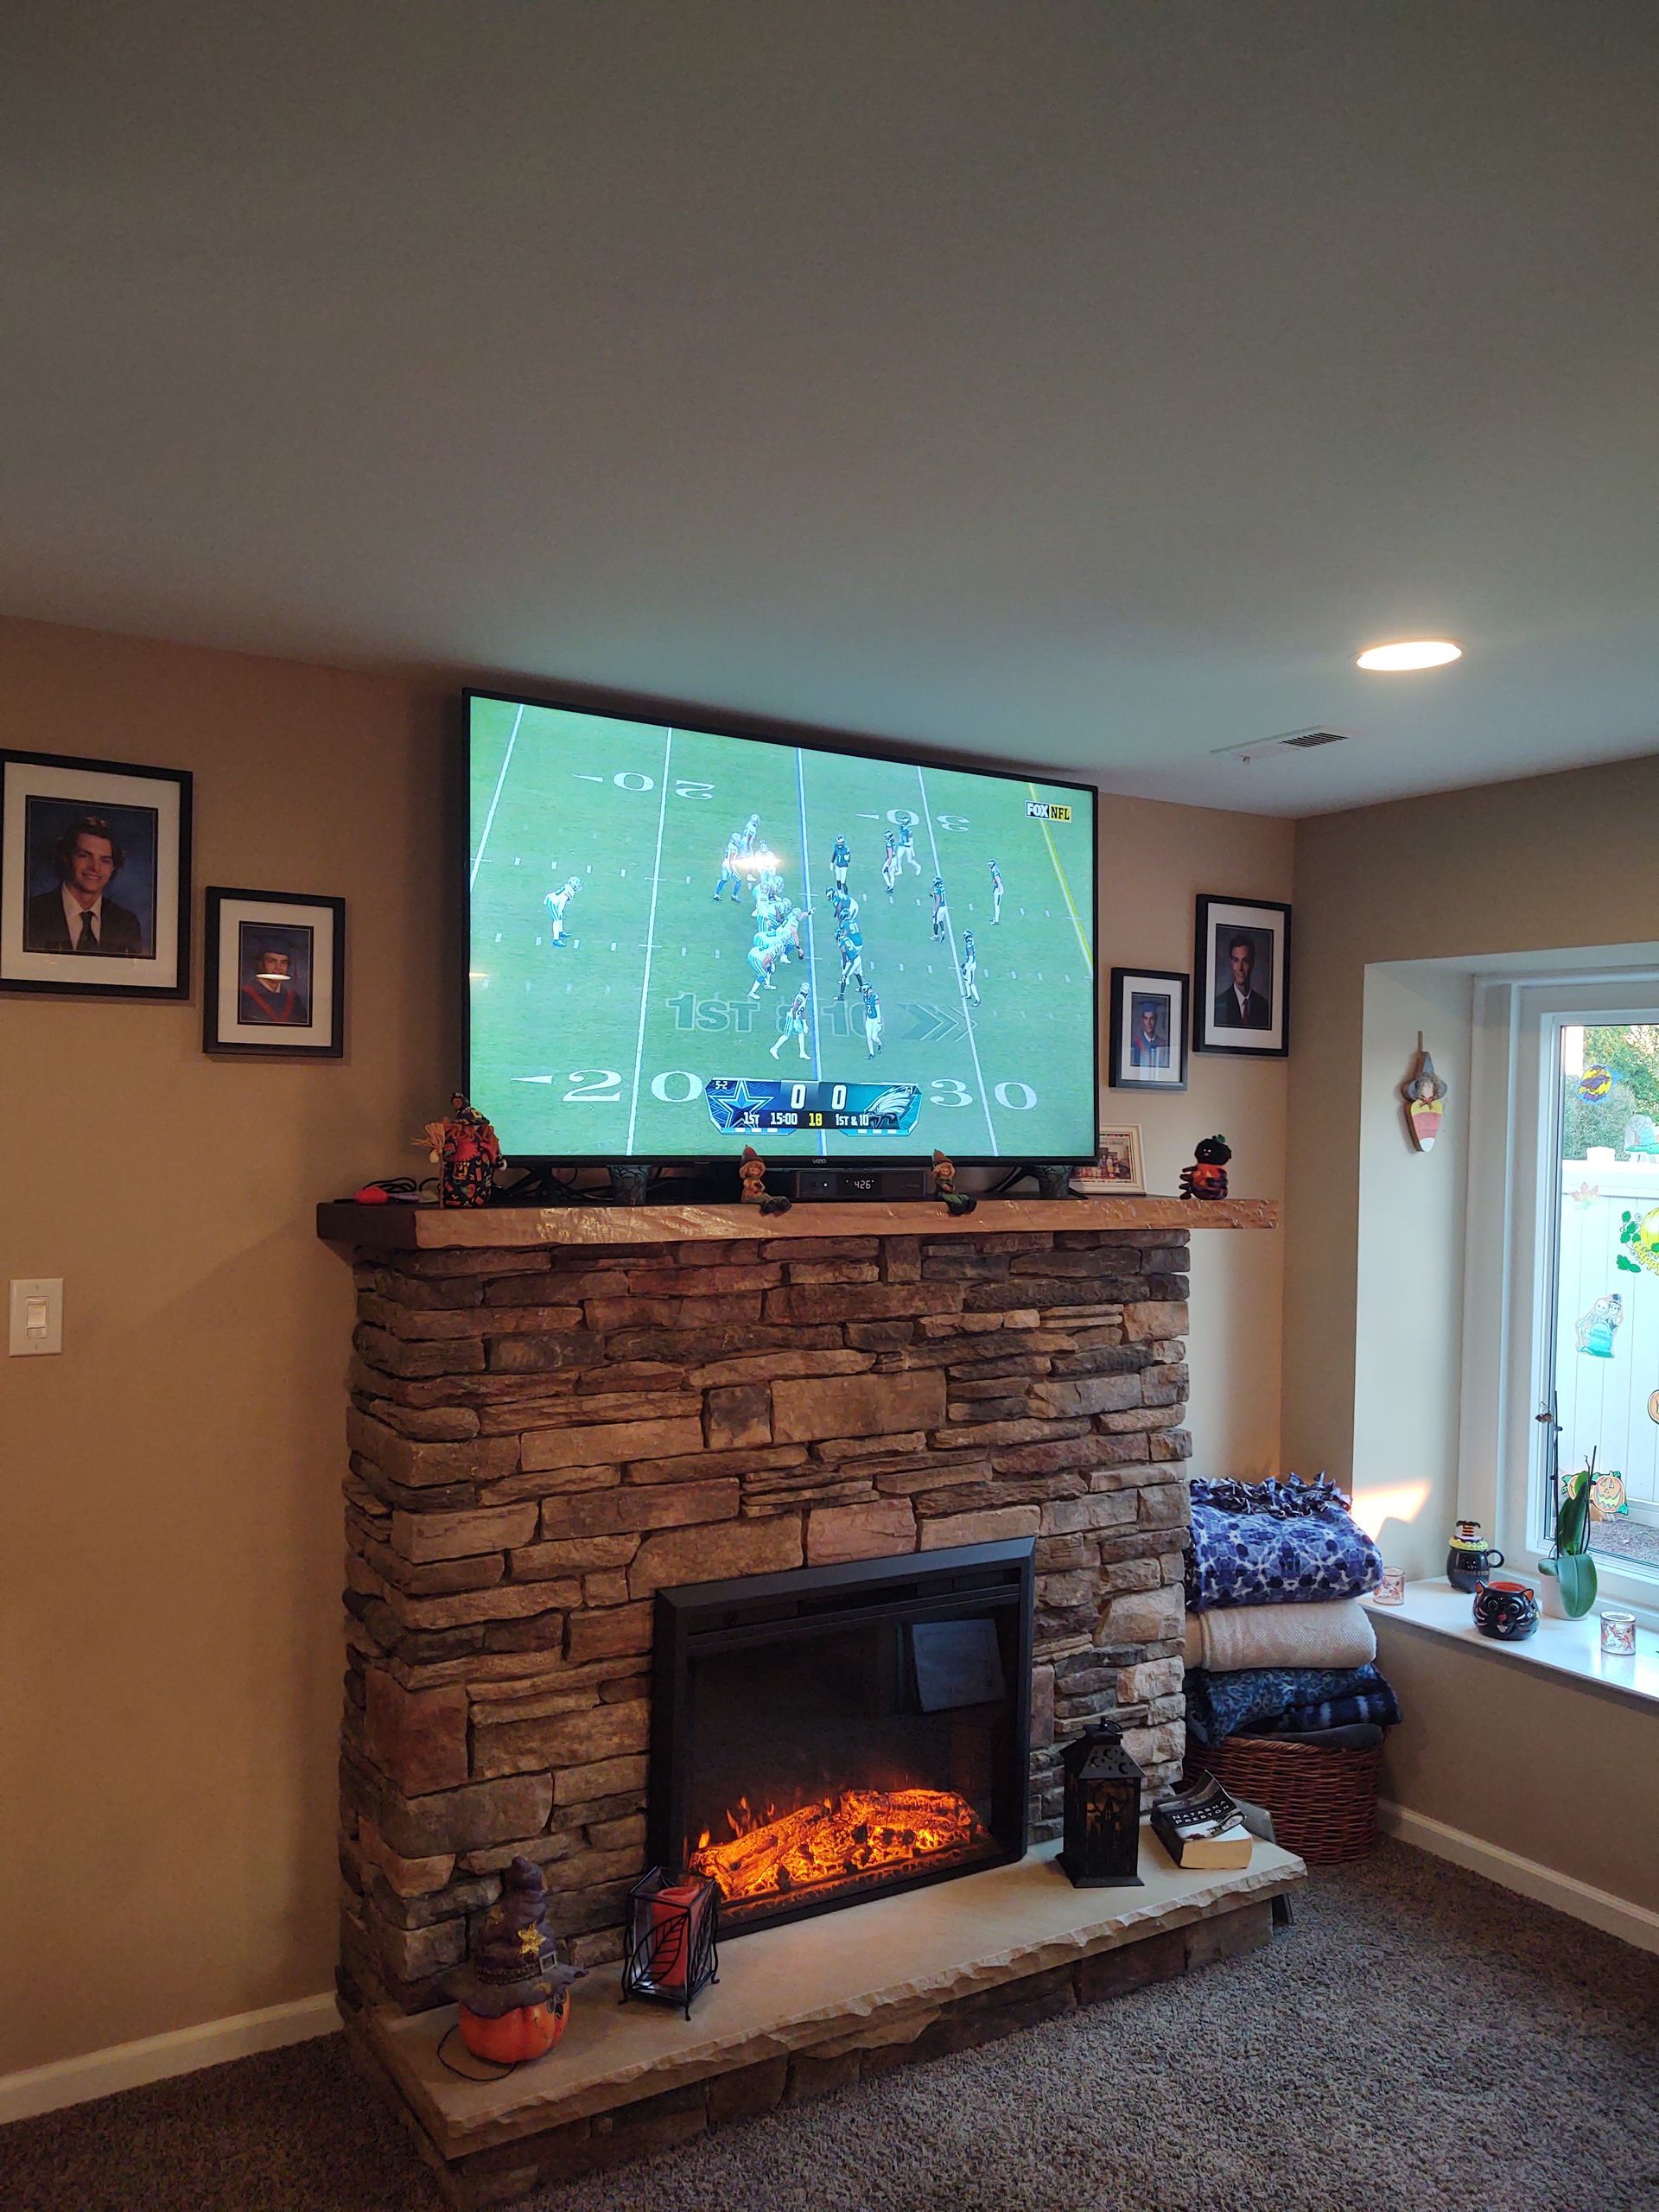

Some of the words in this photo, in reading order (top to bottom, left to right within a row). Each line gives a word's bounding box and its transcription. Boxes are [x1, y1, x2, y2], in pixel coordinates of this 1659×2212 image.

[1027, 802, 1049, 818] FOX
[1051, 805, 1070, 821] NFL
[666, 992, 760, 1033] 1ST
[563, 1069, 703, 1103] 20
[715, 1080, 728, 1090] 5-2
[930, 1078, 1037, 1110] 30
[791, 1084, 806, 1109] 0
[831, 1084, 848, 1110] 0
[744, 1111, 760, 1125] 1ST
[771, 1112, 798, 1125] 15:00
[809, 1112, 823, 1127] 18
[836, 1113, 849, 1126] 1ST
[850, 1116, 859, 1126] &
[859, 1114, 869, 1126] 10
[1172, 1801, 1226, 1819] NATASHA
[1175, 1805, 1230, 1825] PRESTON
